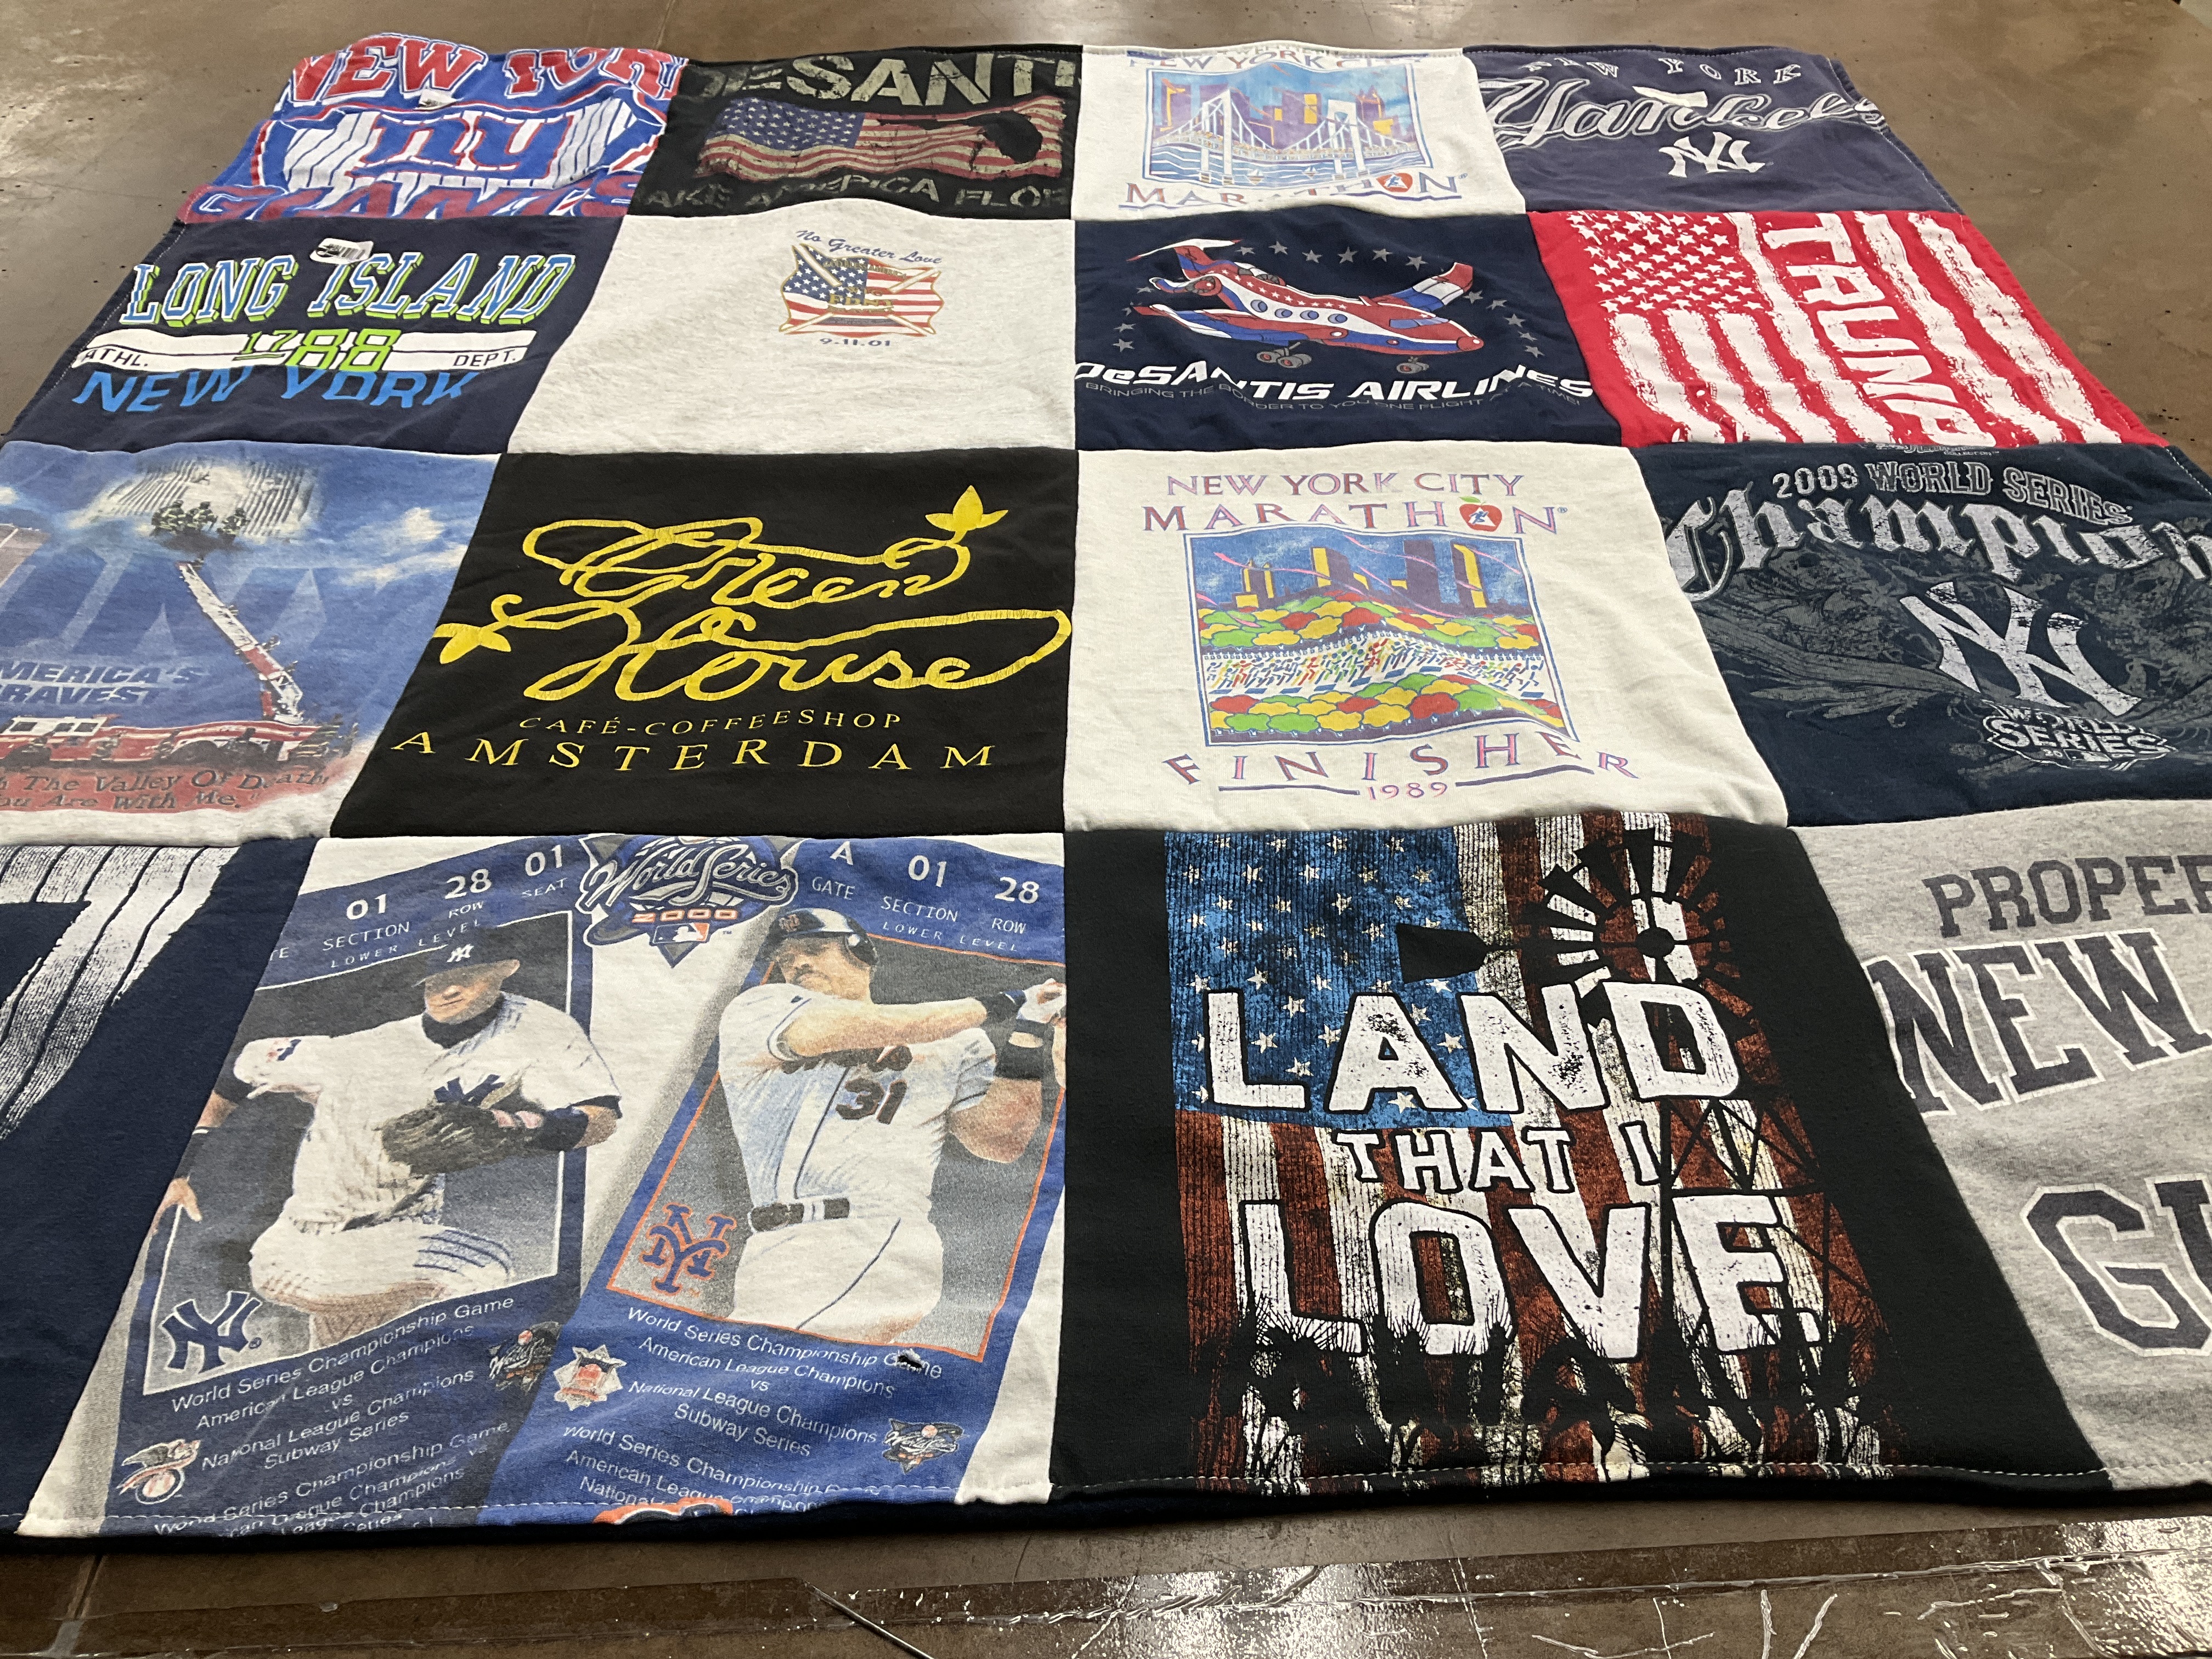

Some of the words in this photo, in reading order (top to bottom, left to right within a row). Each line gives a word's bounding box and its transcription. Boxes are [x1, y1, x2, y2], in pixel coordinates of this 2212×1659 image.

[1658, 58, 1801, 84] YORK
[795, 229, 822, 242] No
[828, 238, 896, 260] Greater
[900, 250, 943, 264] Love
[119, 254, 298, 328] LONG
[307, 252, 576, 326] ISLAND
[233, 328, 404, 371] 1788
[1762, 213, 1997, 448] TRUMP
[82, 347, 149, 368] ATHL.
[453, 348, 517, 368] DEPT.
[72, 365, 248, 412] NEW
[281, 364, 479, 409] YORK
[1086, 382, 1175, 399] BRINGING
[1180, 385, 1214, 398] THE
[1329, 400, 1370, 409] YOU
[1375, 402, 1415, 410] ONE
[1347, 364, 1594, 401] AIRLINES
[1166, 474, 1268, 496] NEW
[1280, 472, 1403, 495] YORK
[1413, 472, 1526, 496] CITY
[1772, 462, 1859, 499] 2009
[1865, 461, 1993, 495] WORLD
[2003, 466, 2134, 525] SERIES
[1899, 581, 2142, 716] NY
[520, 709, 902, 736] CAFÉ-COFFEESHOP
[1990, 719, 2171, 754] SERIES
[391, 730, 996, 771] AMSTERDAM
[1161, 731, 1639, 785] FINISHER
[24, 775, 80, 791] The
[95, 775, 183, 793] Valley
[238, 770, 329, 789] Dath
[1367, 781, 1449, 802] 1989
[112, 793, 176, 809] With
[524, 844, 565, 877] 01
[829, 842, 856, 866] A
[907, 854, 946, 888] 01
[444, 867, 493, 900] 28
[521, 877, 569, 899] SEAT
[584, 842, 715, 907] World
[668, 844, 792, 906] Series
[812, 876, 856, 901] GATE
[994, 876, 1040, 905] 28
[346, 893, 388, 921] 01
[448, 900, 485, 919] ROW
[631, 908, 738, 923] 2000
[880, 895, 958, 923] SECTION
[991, 917, 1027, 935] ROW
[322, 921, 410, 952] SECTION
[330, 944, 399, 968] LOWER
[417, 919, 482, 947] LEVEL
[883, 921, 943, 941] LOWER
[959, 935, 1020, 952] LEVEL
[1862, 927, 2212, 1118] NEW
[1206, 981, 1740, 1113] LAND
[834, 1076, 909, 1125] 31
[1334, 1128, 1573, 1193] THAT
[1621, 1121, 1661, 1186] I
[1244, 1194, 1786, 1361] LOVE
[159, 1291, 263, 1375] NY
[627, 1306, 682, 1333] World
[684, 1324, 742, 1347] Series
[746, 1334, 878, 1368] Championship
[170, 1383, 232, 1414] World
[238, 1366, 302, 1395] Series
[308, 1308, 448, 1373] Championship
[454, 1295, 515, 1319] Game
[293, 1369, 366, 1401] League
[370, 1323, 476, 1374] Champions
[638, 1335, 721, 1371] American
[725, 1360, 790, 1376] League
[794, 1363, 897, 1400] Champions
[331, 1393, 354, 1410] vs
[750, 1378, 771, 1392] vs
[288, 1410, 362, 1443] League
[366, 1369, 476, 1417] Champions
[628, 1380, 701, 1400] National
[702, 1385, 771, 1420] League
[775, 1404, 878, 1444] Champions
[264, 1436, 342, 1470] Subway
[348, 1410, 410, 1443] Series
[563, 1426, 617, 1446] World
[618, 1433, 681, 1468] Series
[674, 1402, 749, 1443] Subway
[752, 1426, 812, 1458] Series
[296, 1443, 443, 1498] Championship
[449, 1421, 511, 1449] Game
[566, 1449, 652, 1488] American
